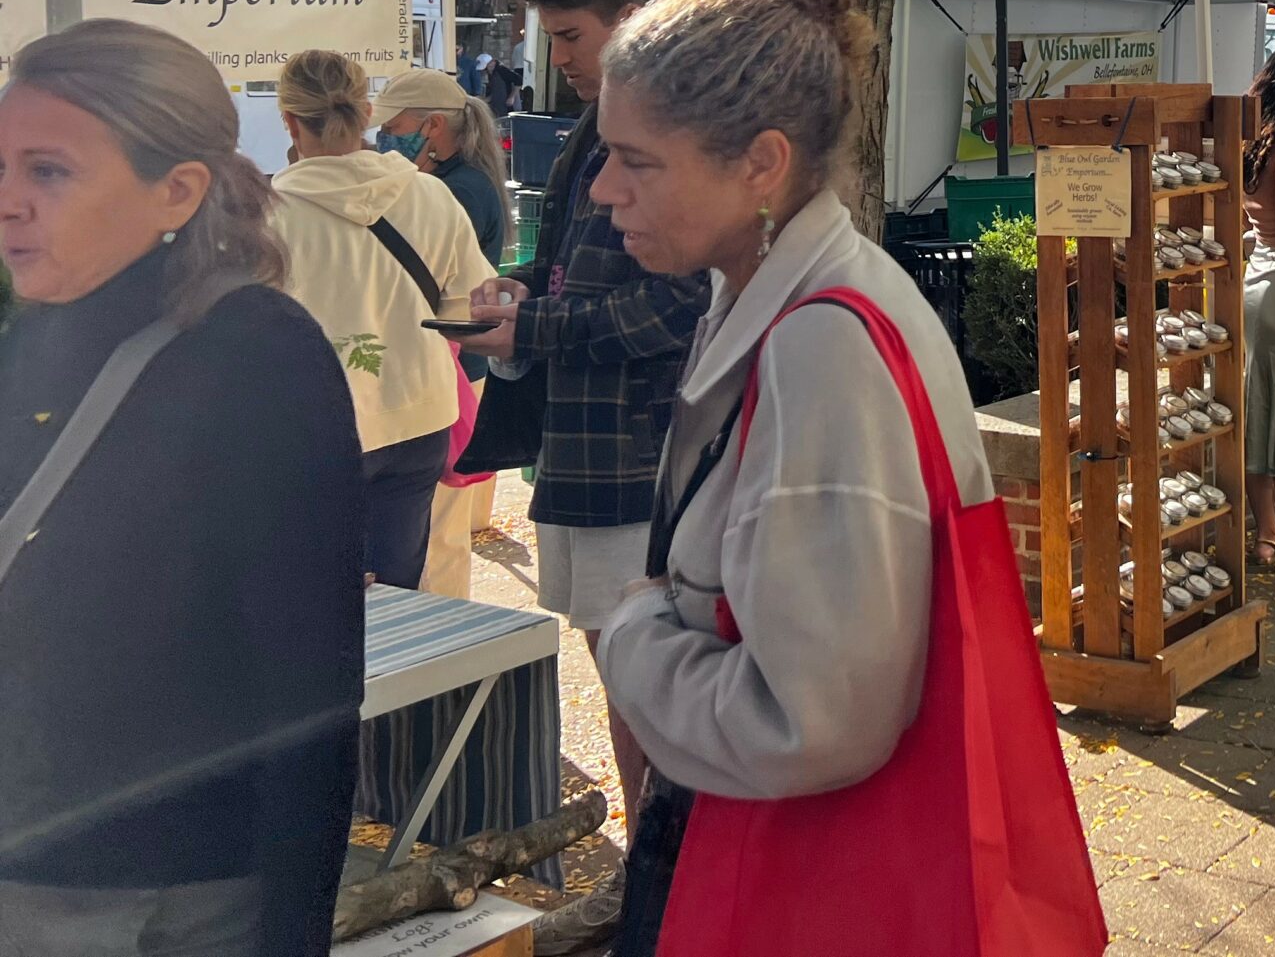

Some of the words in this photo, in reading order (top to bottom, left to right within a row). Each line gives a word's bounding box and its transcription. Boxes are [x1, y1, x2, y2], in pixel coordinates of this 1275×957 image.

[1038, 36, 1111, 61] Wishwell
[1115, 37, 1155, 58] Farms
[207, 51, 240, 68] illing
[245, 50, 288, 67] planks
[366, 48, 394, 62] fruits
[1141, 64, 1153, 77] OH
[1058, 154, 1075, 163] Blue
[1077, 154, 1091, 163] Owl
[1093, 154, 1120, 165] Garden
[1068, 183, 1080, 192] We
[1082, 183, 1102, 192] Grow
[1072, 194, 1097, 202] Herbs!
[392, 920, 434, 942] Logs
[414, 928, 451, 948] your
[454, 910, 493, 929] own!
